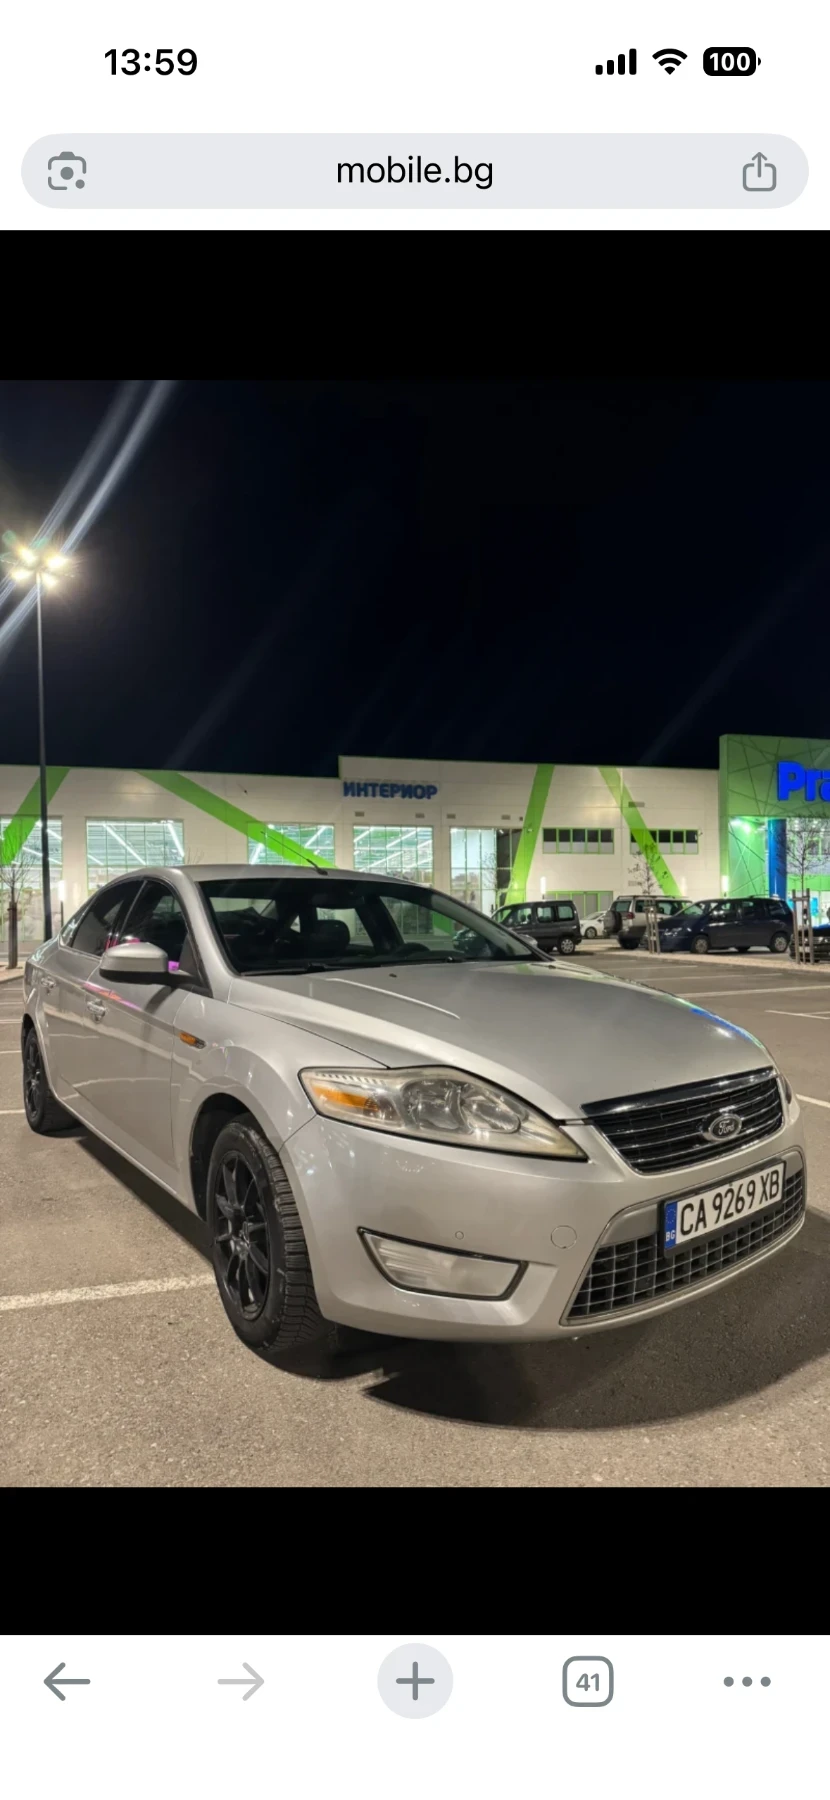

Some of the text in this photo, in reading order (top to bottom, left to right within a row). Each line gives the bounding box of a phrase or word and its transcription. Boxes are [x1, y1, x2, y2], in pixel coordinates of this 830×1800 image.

[104, 48, 198, 77] 13:59
[709, 52, 751, 72] 100
[336, 154, 493, 190] mobile.bg
[343, 781, 438, 800] ИНТЕРИОР
[718, 1120, 734, 1135] Ford
[680, 1169, 779, 1236] CA 9269 XB
[665, 1230, 676, 1242] BG
[575, 1672, 600, 1692] 41
